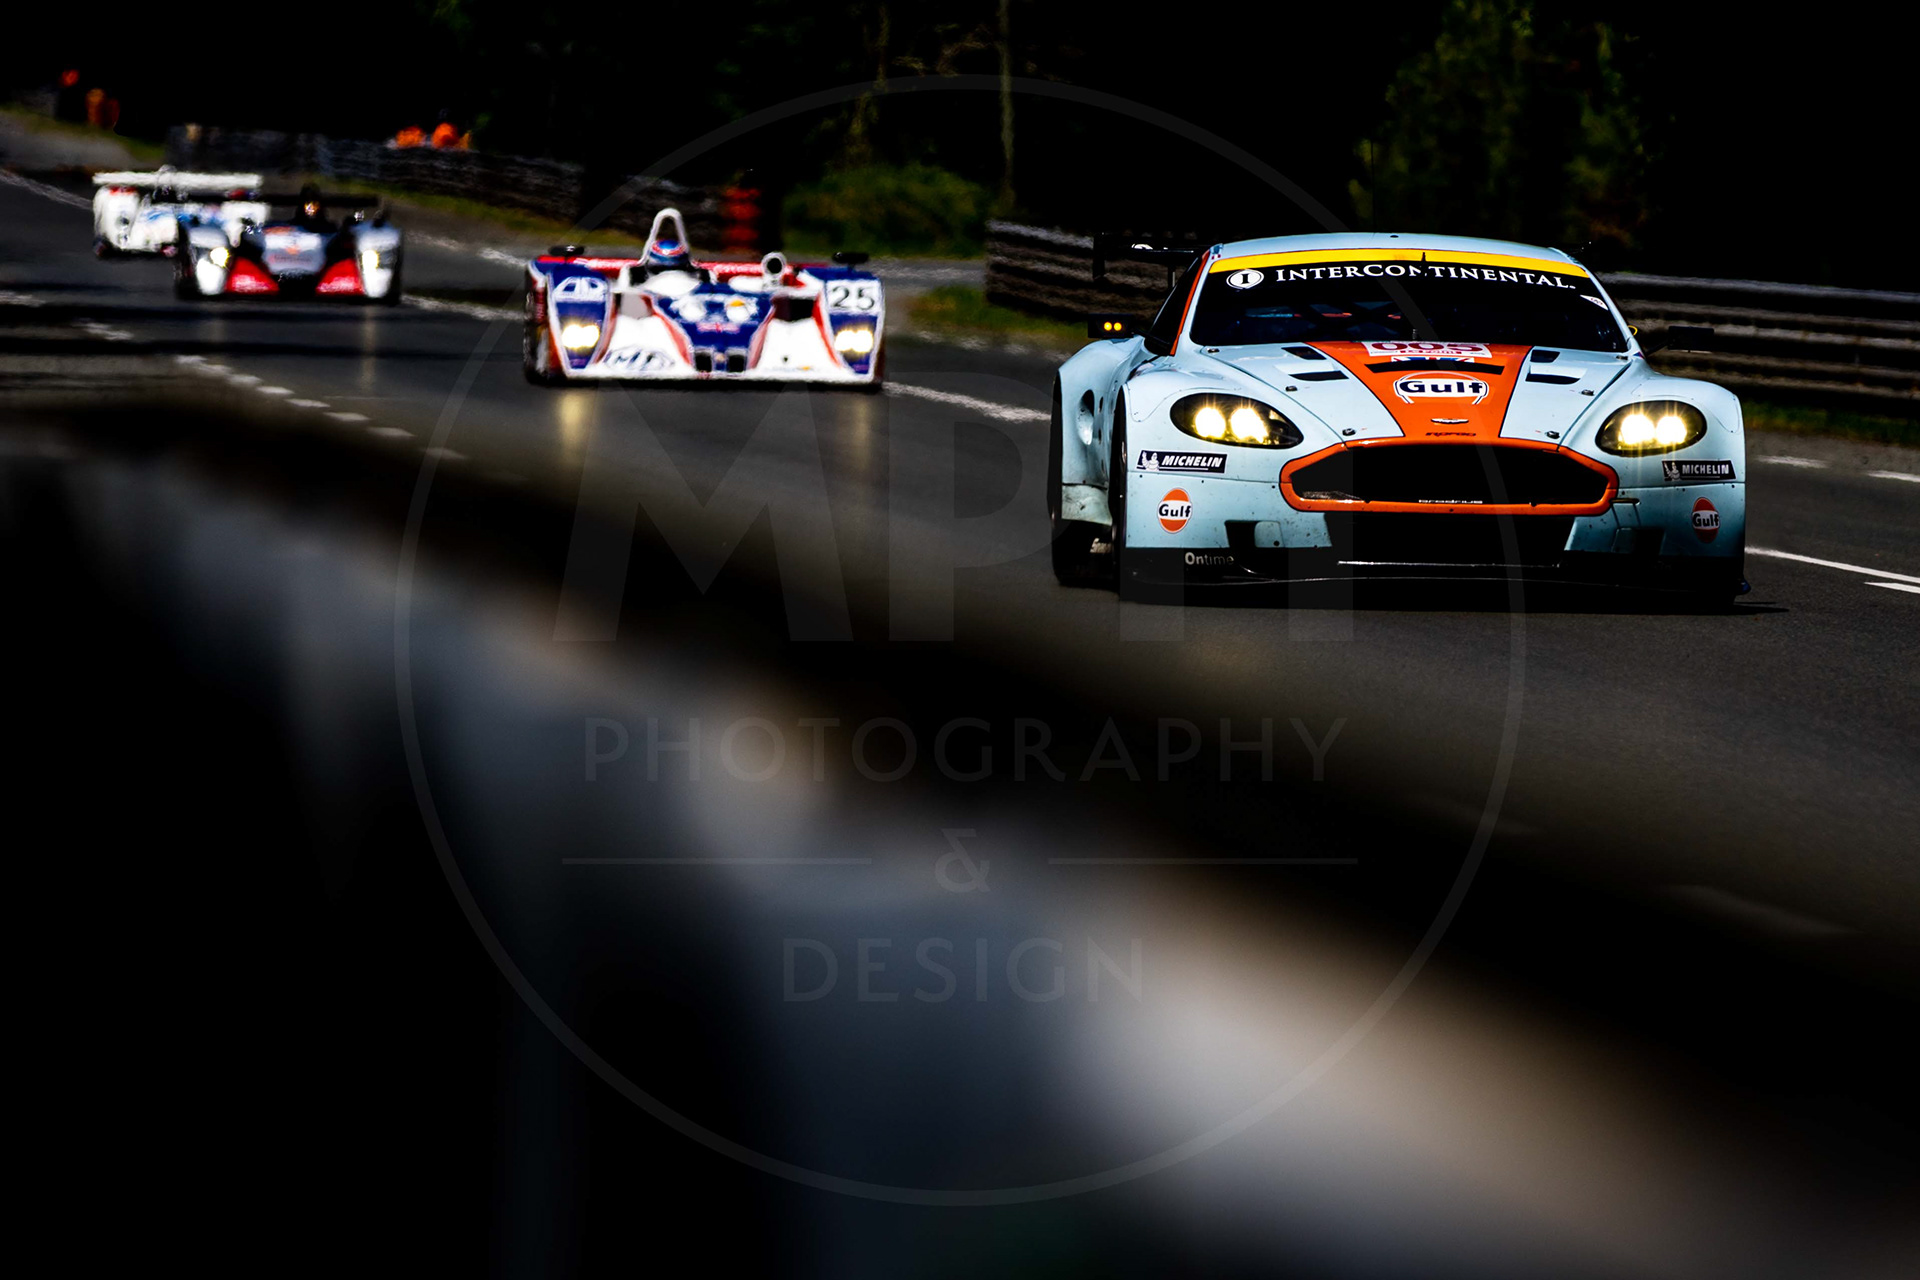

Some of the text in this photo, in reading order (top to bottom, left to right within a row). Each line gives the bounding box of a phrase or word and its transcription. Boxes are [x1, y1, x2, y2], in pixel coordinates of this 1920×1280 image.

[1275, 264, 1569, 289] INTERCONTINENTAL
[830, 284, 876, 311] 25
[1399, 380, 1484, 394] Gulf
[1161, 454, 1223, 468] MICHELIN
[1682, 464, 1730, 475] MICHELIN
[1158, 503, 1192, 518] Gulf
[1692, 513, 1719, 527] Gulf
[1184, 551, 1235, 566] Ontime
